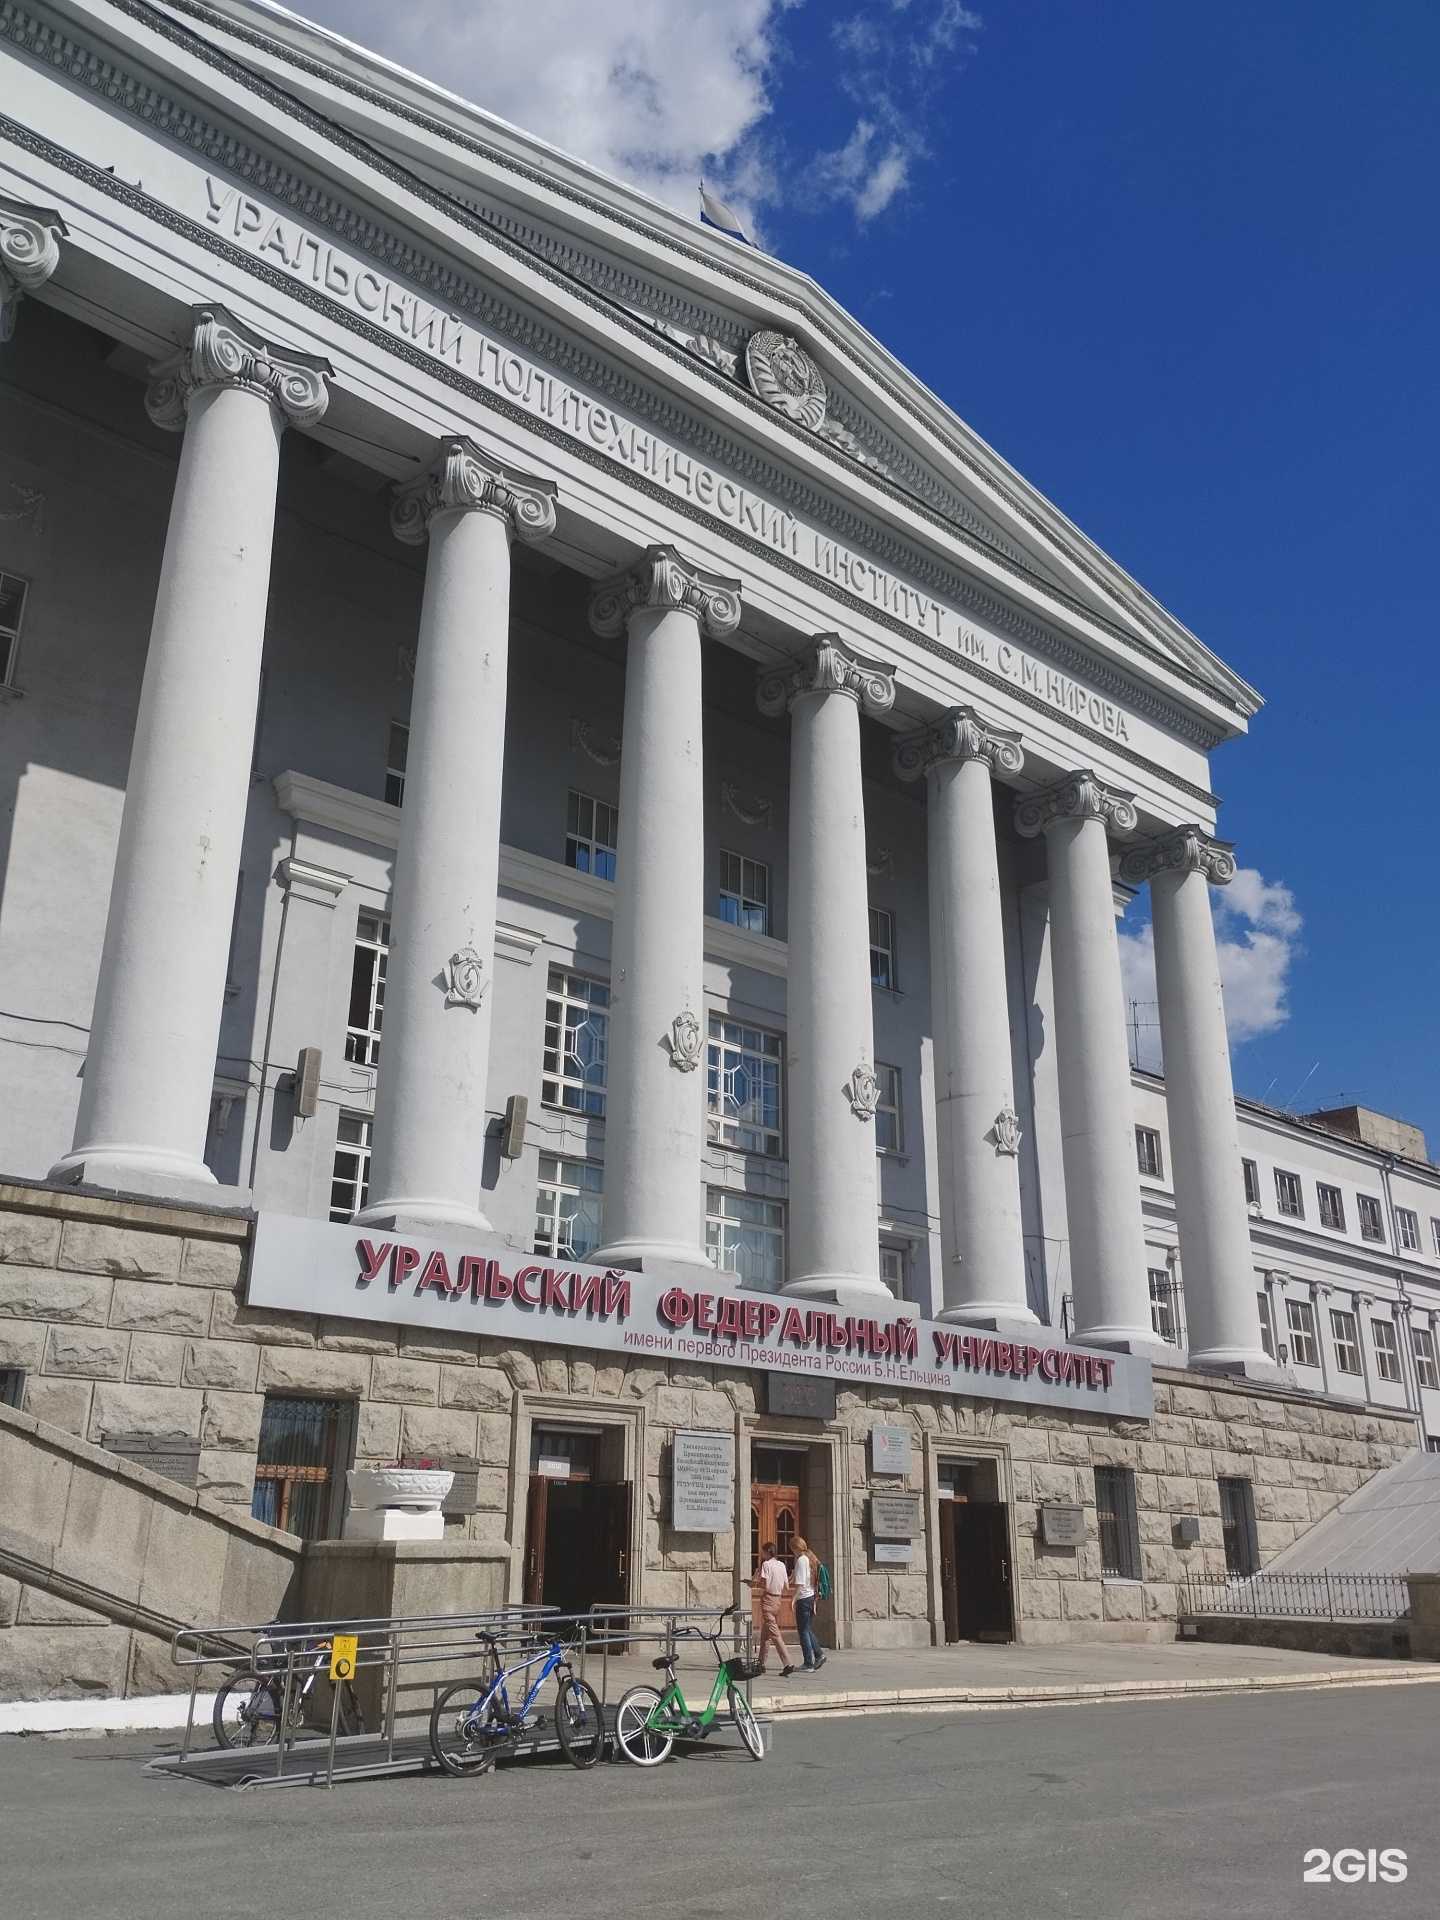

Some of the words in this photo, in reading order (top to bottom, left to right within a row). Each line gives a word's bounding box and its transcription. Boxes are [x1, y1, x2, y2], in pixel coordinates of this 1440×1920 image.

[206, 176, 464, 364] УРАЛЬСКИЙ
[477, 335, 801, 555] ПОЛИТЕХНИЧЕСКИЙ
[813, 534, 947, 637] ИНСТИТУТ
[357, 1239, 631, 1318] УРАЛЬСКИЙ
[661, 1287, 919, 1360] ФЕДЕРАЛЬНЫЙ
[934, 1331, 1115, 1386] УНИВЕРСИТЕТ
[624, 1331, 673, 1350] имени
[678, 1339, 736, 1359] первого
[740, 1343, 821, 1368] Президента
[826, 1354, 871, 1376] России
